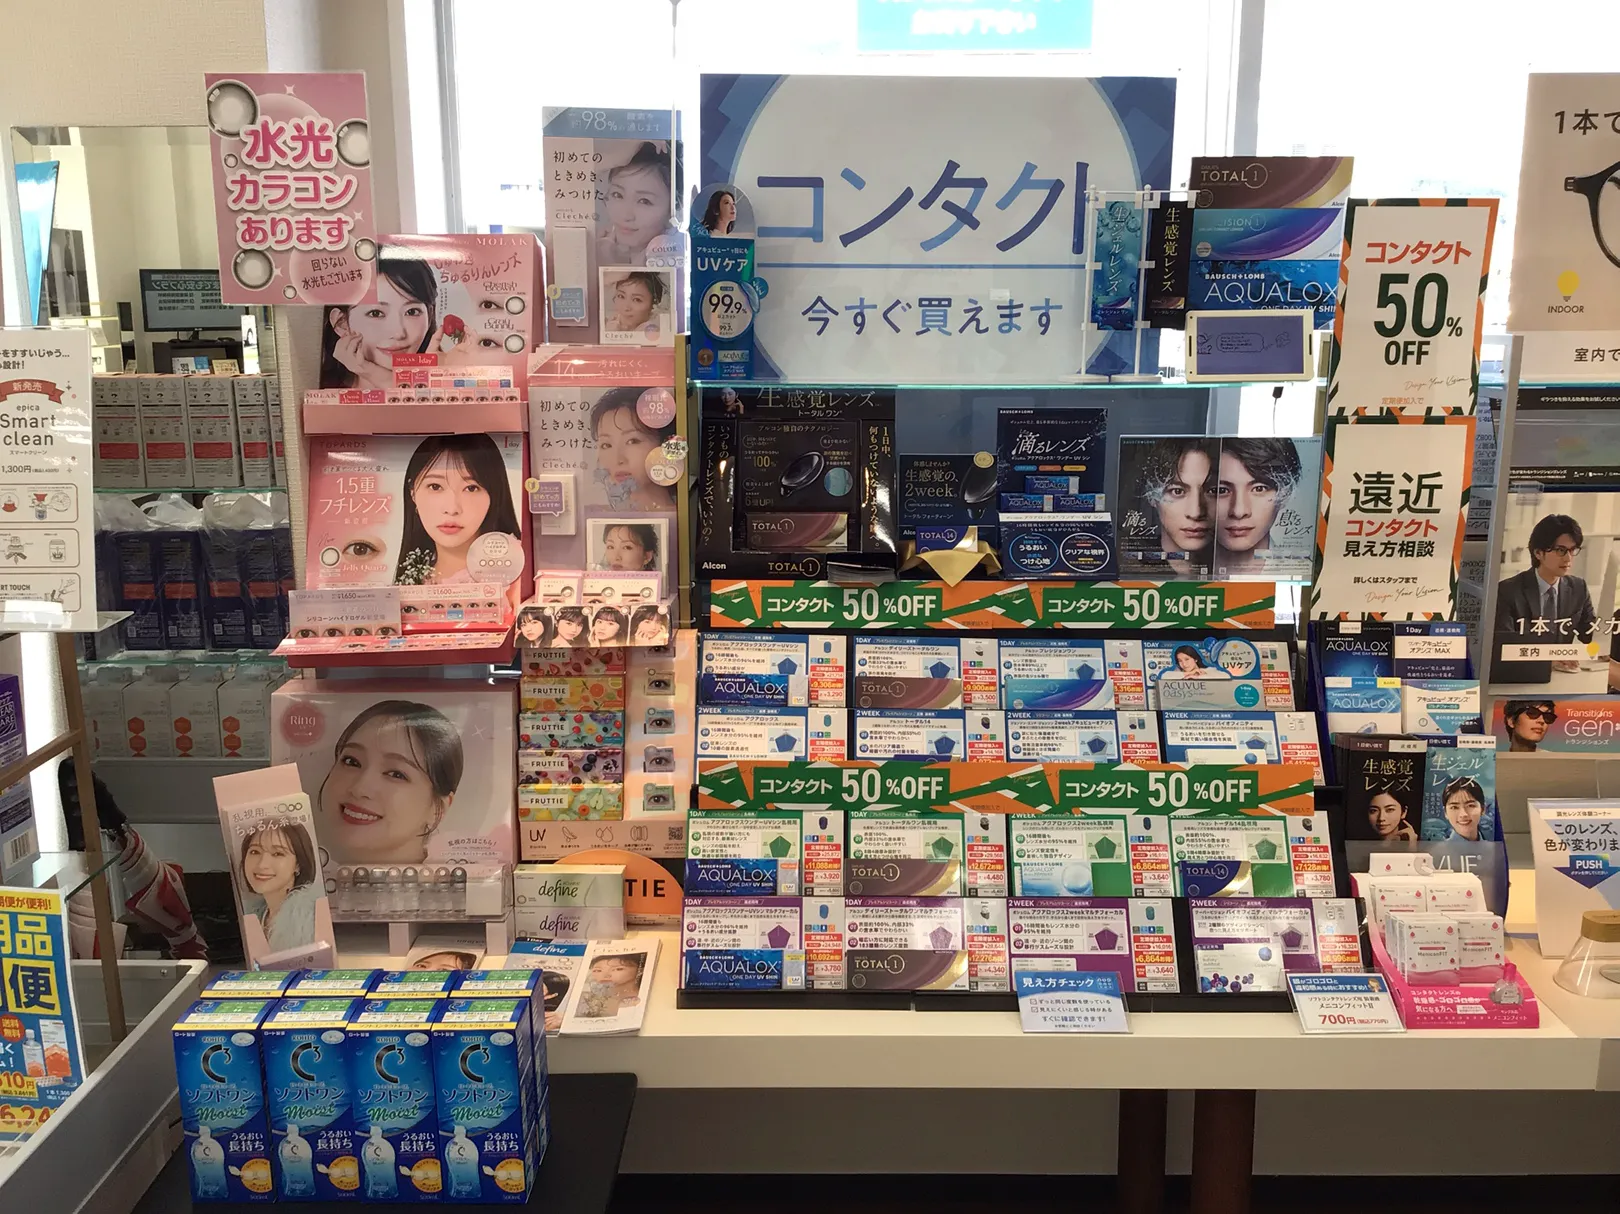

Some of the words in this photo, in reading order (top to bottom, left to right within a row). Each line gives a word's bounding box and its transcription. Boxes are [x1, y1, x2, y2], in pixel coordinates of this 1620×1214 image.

[245, 119, 334, 164] 水光
[553, 151, 603, 163] 初めての
[554, 169, 603, 183] ときめき、
[1201, 170, 1248, 181] TOTAL
[231, 173, 353, 205] カラコン
[240, 217, 349, 247] あります
[476, 237, 529, 246] MOLAK
[1106, 206, 1129, 294] 生ジェルレンズ
[1162, 207, 1181, 292] 生感覚レンズ
[1365, 241, 1472, 264] コンタクト
[311, 257, 348, 272] 回らない
[697, 258, 749, 272] UVケア
[302, 269, 364, 290] 水光もございます
[1204, 281, 1338, 303] AQUALOX
[708, 293, 747, 314] 99.9%
[1374, 272, 1463, 338] 50%
[1548, 305, 1584, 314] INDOOR
[802, 295, 1063, 336] 今すぐ買えます
[1384, 341, 1431, 366] OFF
[12, 382, 42, 392] 新発売
[756, 386, 877, 408] 生感覚レンズ
[16, 404, 40, 412] epica
[540, 401, 590, 412] 初めての
[0, 413, 56, 428] Smart
[541, 420, 592, 431] ときめき、
[3, 431, 54, 446] clean
[719, 426, 730, 458] いつもの
[1011, 431, 1093, 455] 滴るレンズ
[1, 465, 31, 473] 1,300円
[905, 470, 959, 482] 生感覚の、
[336, 476, 377, 495] 1.5重
[1348, 471, 1443, 515] 遠近
[752, 522, 782, 530] TOTAL
[1129, 525, 1158, 536] レンズ
[1284, 525, 1314, 536] レンズ
[1345, 519, 1439, 537] コンタクト
[1343, 541, 1435, 558] 見え方相談
[702, 562, 727, 570] Alcon
[768, 563, 805, 572] TOTAL
[1353, 576, 1418, 585] 詳しくはスタッフまで
[1365, 592, 1393, 603] Design
[1395, 588, 1413, 600] Your
[1415, 586, 1444, 598] Vision
[767, 597, 834, 613] コンタクト
[842, 588, 879, 621] 50
[1048, 598, 1116, 614] コンタクト
[1123, 589, 1160, 621] 50
[1326, 641, 1389, 652] AQUALOX
[1519, 647, 1540, 657] 室内
[1222, 661, 1252, 669] UVケア
[715, 683, 785, 693] AQUALOX
[1163, 682, 1206, 690] ACUVUE
[1332, 698, 1397, 709] AQUALOX
[290, 715, 316, 727] Ring
[1567, 708, 1613, 720] Transitions
[1362, 758, 1414, 775] 生感覚
[1430, 755, 1485, 771] 生ジェル
[760, 778, 833, 796] コンタクト
[842, 769, 881, 803] 50
[1364, 776, 1414, 792] レンズ
[1432, 773, 1480, 788] レンズ
[1065, 782, 1139, 799] コンタクト
[1148, 772, 1189, 808] 50
[529, 829, 546, 842] UV
[1554, 822, 1619, 836] このレンズ、
[1575, 860, 1603, 869] PUSH
[698, 869, 773, 881] AQUALOX
[852, 868, 885, 876] TOTAL
[538, 879, 578, 902] define
[540, 914, 579, 937] define
[700, 960, 778, 973] AQUALOX
[855, 960, 890, 968] TOTAL
[1022, 977, 1094, 988] 見え方チェック
[1318, 1014, 1356, 1025] 700円
[185, 1089, 256, 1103] ソフトワン
[274, 1087, 345, 1101] ソフトワン
[359, 1089, 429, 1103] ソフトワン
[442, 1089, 513, 1103] ソフトワン
[196, 1104, 247, 1122] Moist
[284, 1101, 335, 1120] Moist
[367, 1104, 419, 1122] Moist
[451, 1104, 503, 1122] Moist
[230, 1132, 264, 1141] うるおい
[319, 1130, 352, 1139] うるおい
[402, 1132, 435, 1141] うるおい
[486, 1132, 519, 1141] うるおい
[228, 1140, 265, 1152] 長持ち
[316, 1138, 353, 1150] 長持ち
[400, 1140, 436, 1152] 長持ち
[483, 1140, 519, 1152] 長持ち
